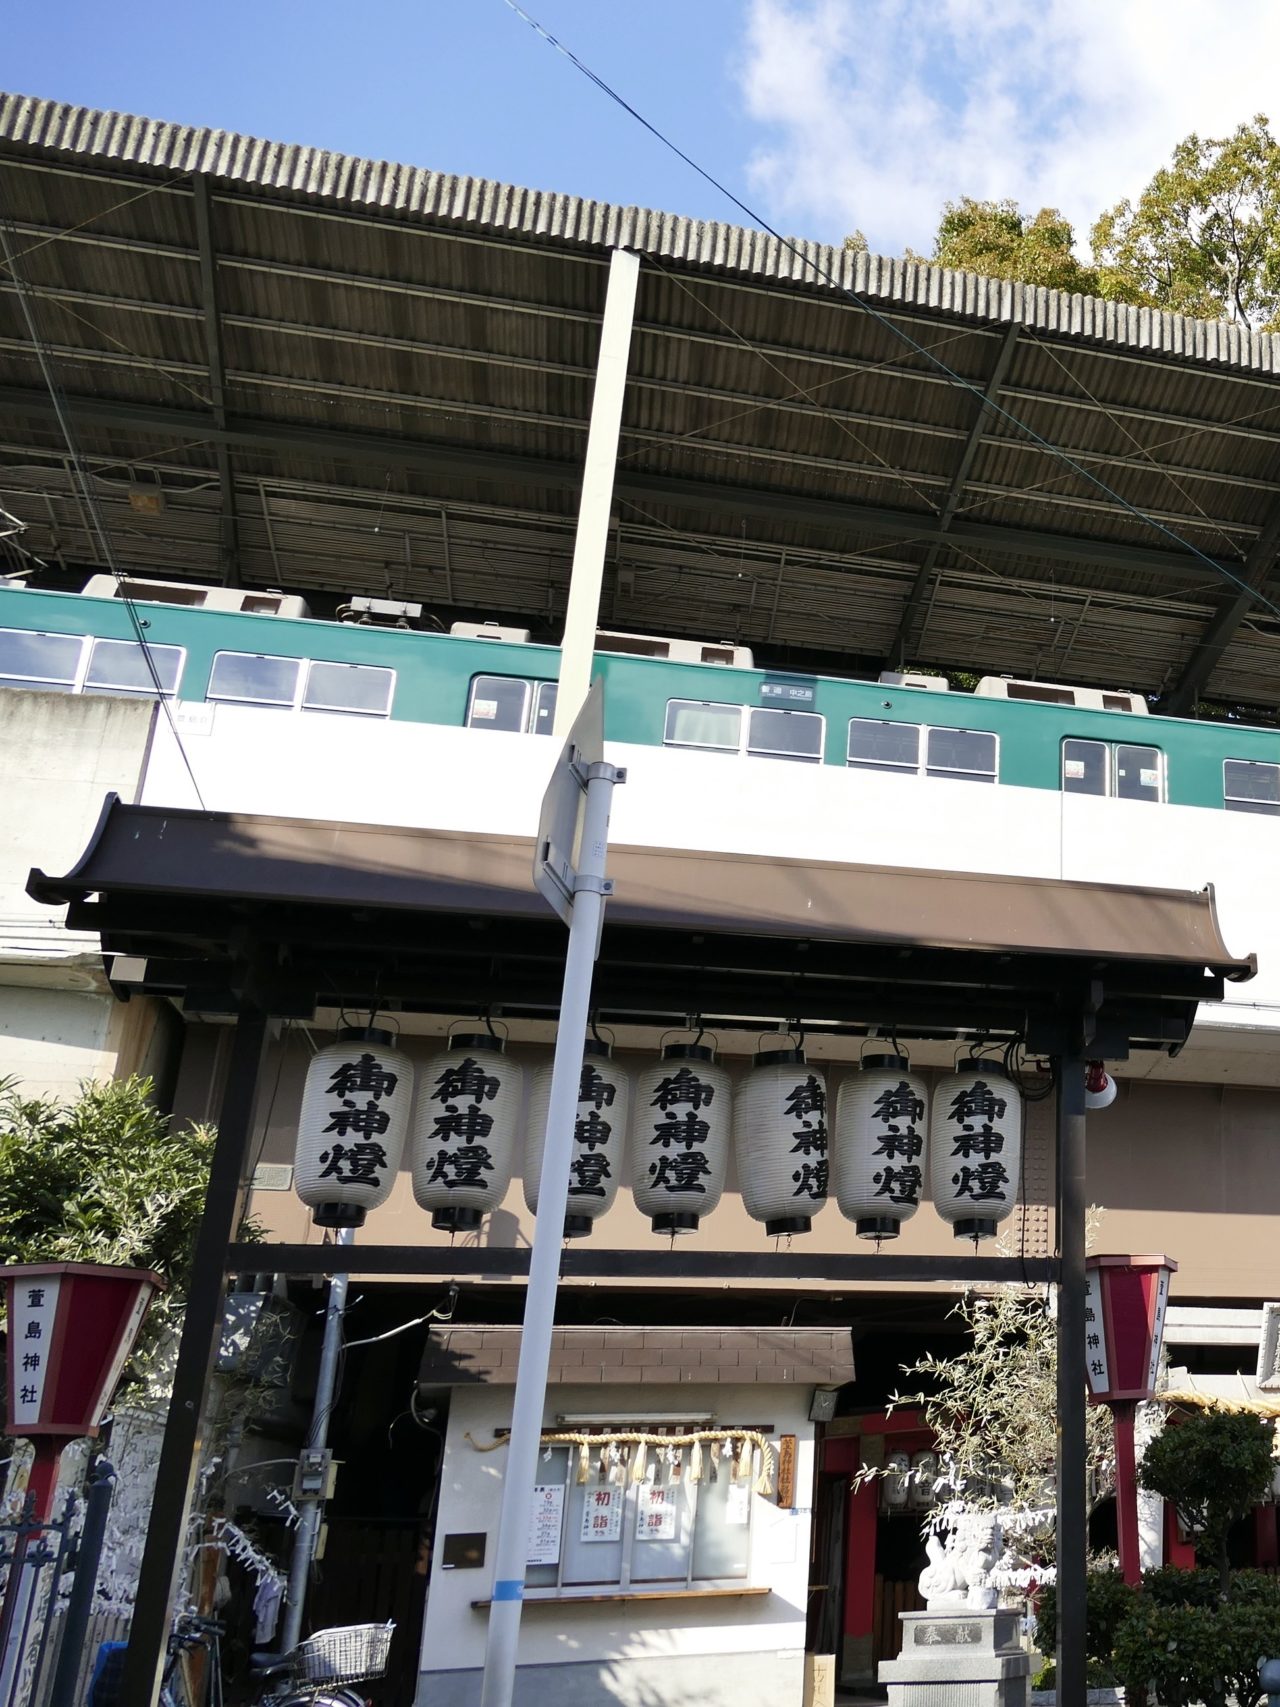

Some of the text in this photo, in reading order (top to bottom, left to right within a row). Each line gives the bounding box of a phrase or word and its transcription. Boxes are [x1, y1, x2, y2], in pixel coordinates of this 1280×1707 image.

[319, 1053, 398, 1187] 御神燈
[426, 1057, 500, 1189] 御神燈
[648, 1067, 716, 1193] 御神燈
[947, 1080, 1011, 1201] 御神燈
[20, 1289, 46, 1405] 萱島神社
[593, 1490, 611, 1529] 初詣
